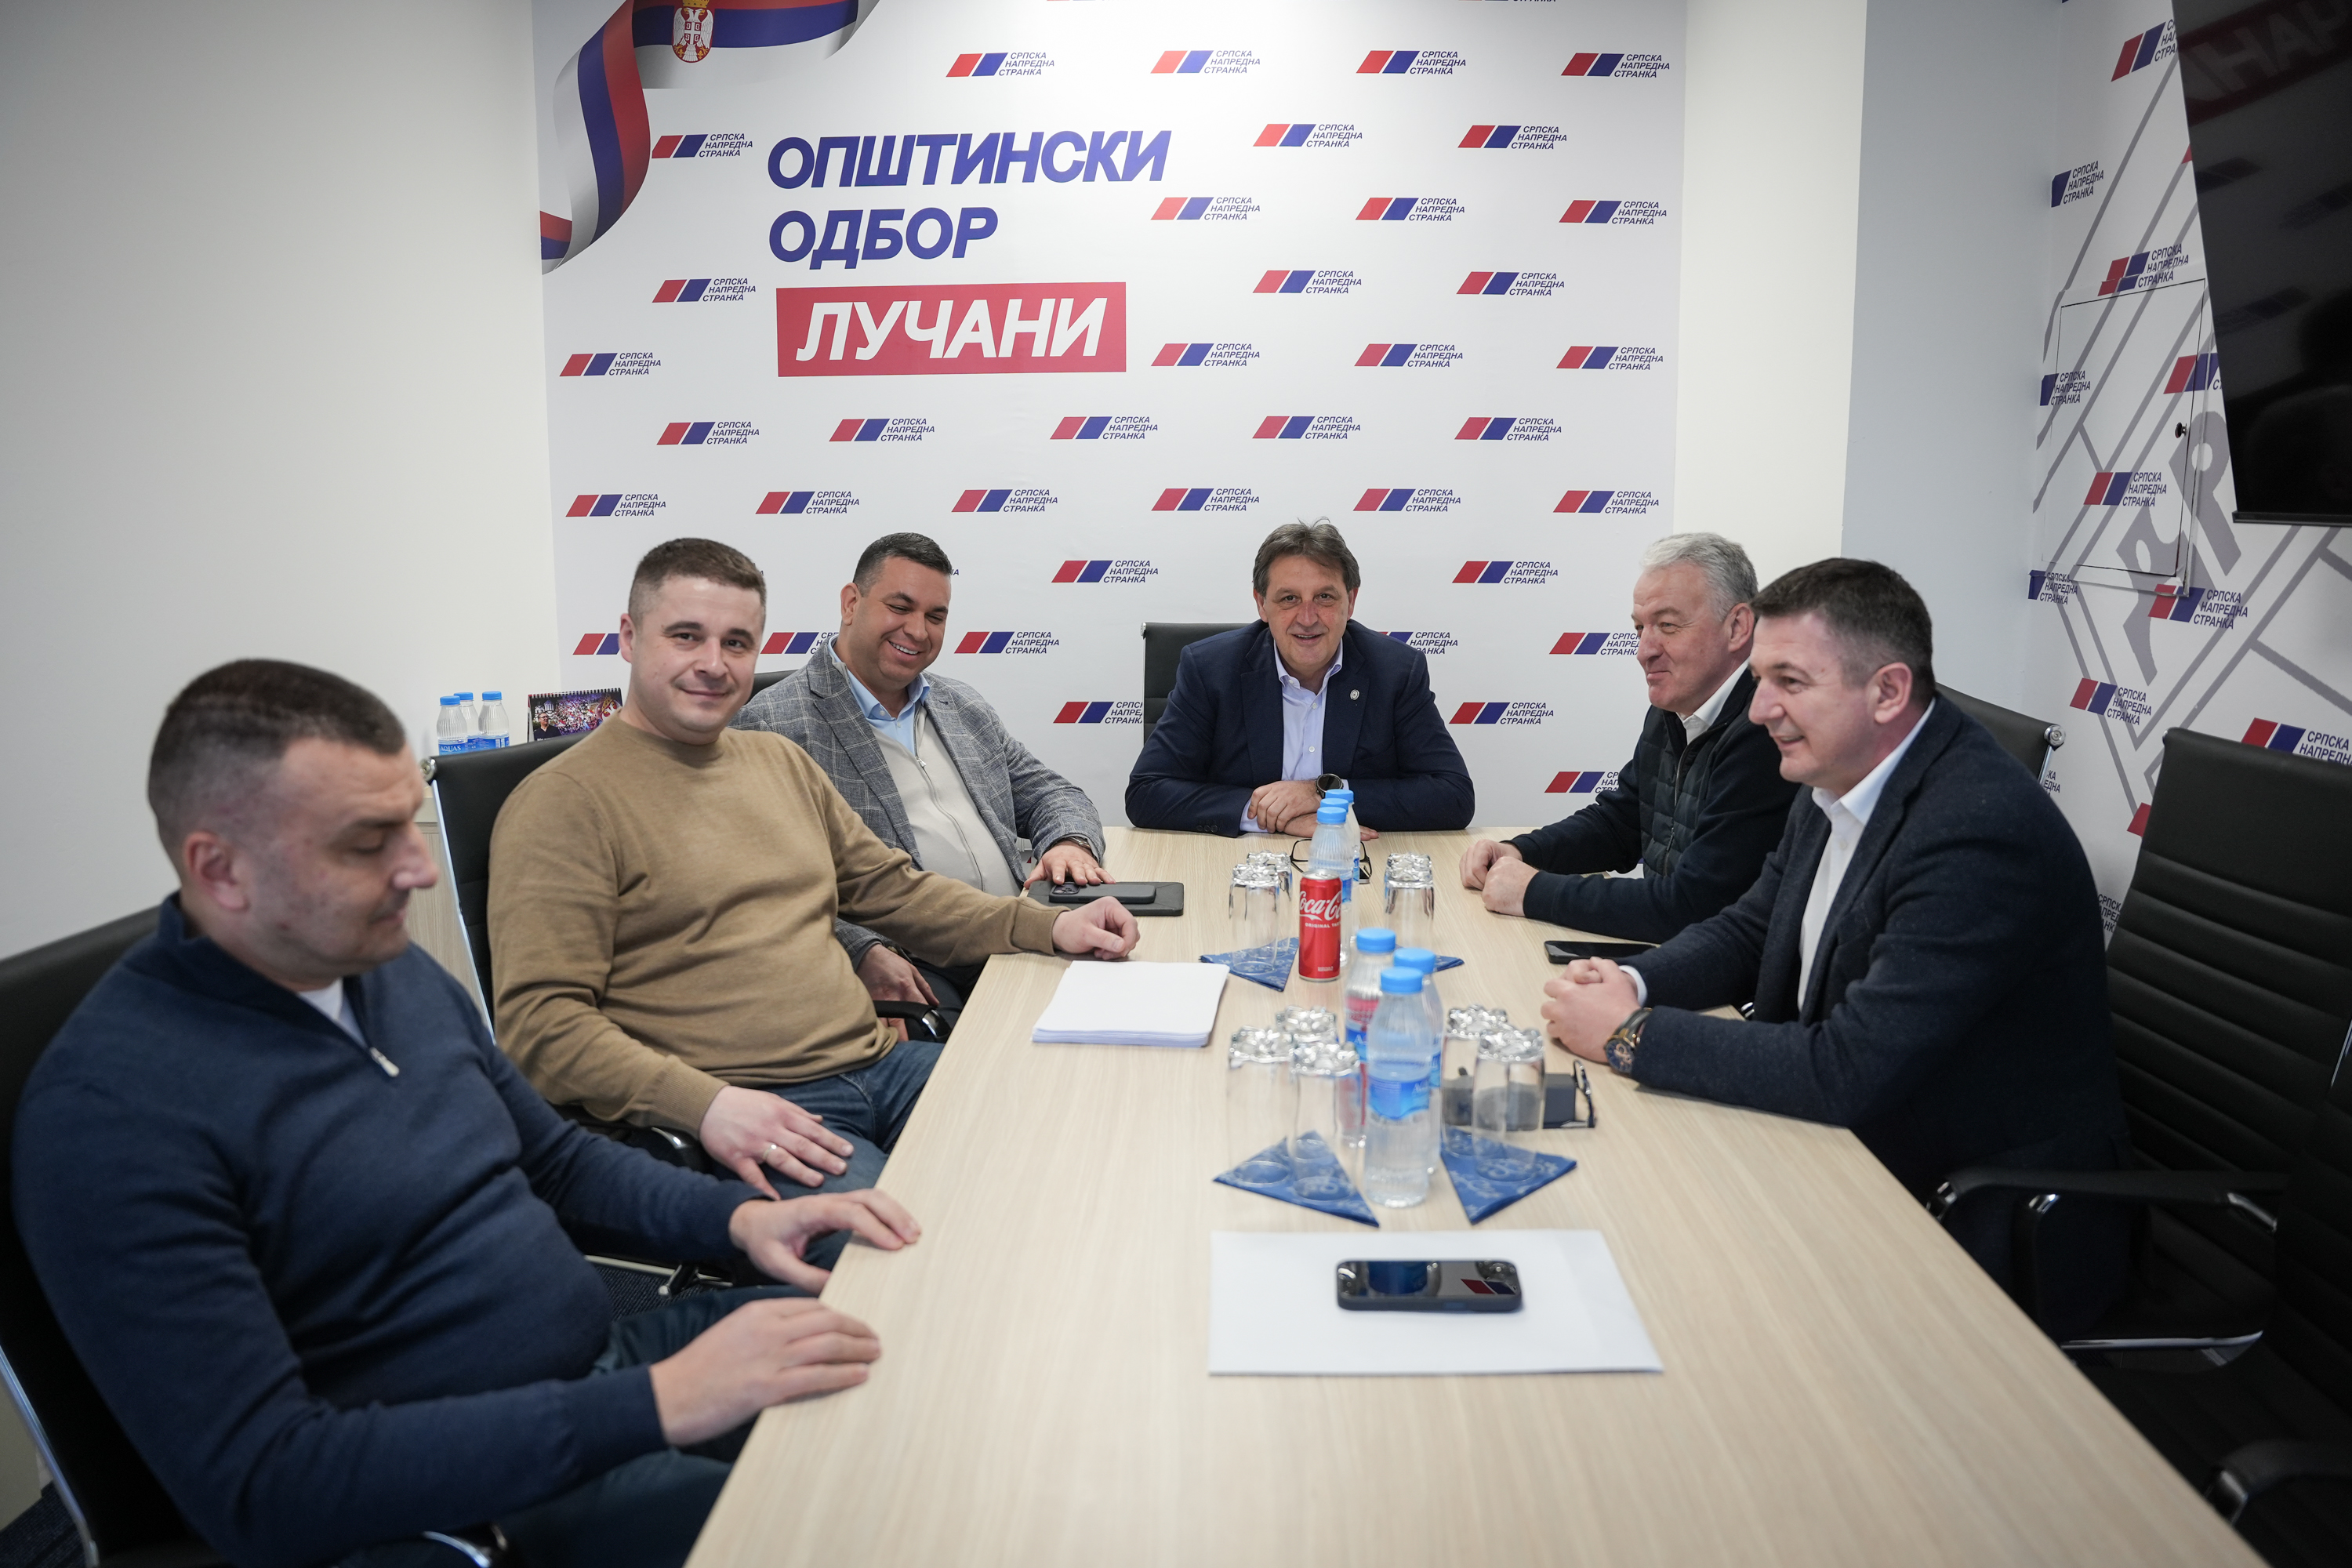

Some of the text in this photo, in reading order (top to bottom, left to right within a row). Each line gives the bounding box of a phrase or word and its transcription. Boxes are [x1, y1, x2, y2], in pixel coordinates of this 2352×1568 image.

[2154, 43, 2176, 62] СТРА
[1415, 59, 1466, 67] НАПРЕДНА
[1620, 62, 1670, 71] НАПРЕДНА
[710, 132, 745, 141] СРПСКА
[1312, 132, 1363, 140] НАПРЕДНА
[1517, 133, 1567, 143] НАПРЕДНА
[704, 140, 753, 149] НАПРЕДНА
[768, 130, 1172, 190] ОПШТИНСКИ
[2072, 161, 2099, 178] СРПСКА
[2068, 169, 2104, 191] НАПРЕДНА
[2063, 186, 2093, 205] СТРАНКА
[1210, 205, 1261, 213] НАПРЕДНА
[1415, 205, 1465, 214] НАПРЕДНА
[1617, 209, 1668, 217] НАПРЕДНА
[769, 206, 999, 270] ОДБОР
[2151, 243, 2182, 260] СРПСКА
[2147, 255, 2189, 273] НАПРЕДНА
[1312, 278, 1362, 287] НАПРЕДНА
[1515, 280, 1565, 289] НАПРЕДНА
[2138, 270, 2173, 288] СТРАНКА
[708, 285, 757, 294] НАПРЕДНА
[795, 297, 1108, 361] ЛУЧАНИ
[1210, 350, 1260, 359] НАПРЕДНА
[1614, 354, 1664, 363] НАПРЕДНА
[614, 359, 662, 368] НАПРЕДНА
[2060, 370, 2085, 382] СРПСКА
[2055, 380, 2091, 394] НАПРЕДНА
[2051, 394, 2081, 405] СТРАНКА
[1512, 425, 1562, 434] НАПРЕДНА
[2133, 472, 2161, 482] СРПСКА
[2128, 484, 2167, 496] НАПРЕДНА
[811, 498, 860, 506] НАПРЕДНА
[1009, 496, 1058, 505] НАПРЕДНА
[1210, 495, 1260, 504] НАПРЕДНА
[1411, 496, 1461, 505] НАПРЕДНА
[1610, 499, 1660, 507] НАПРЕДНА
[2122, 496, 2155, 506] СТРАНКА
[1509, 568, 1559, 577] НАПРЕДНА
[2045, 582, 2078, 595] НАПРЕДНА
[2040, 593, 2068, 604] СТРАНКА
[2207, 590, 2241, 603] СРПСКА
[2200, 601, 2248, 618] НАПРЕДНА
[2194, 614, 2234, 630] СТРАНКА
[1410, 639, 1458, 648] НАПРЕДНА
[2118, 687, 2147, 702] СРПСКА
[2113, 697, 2152, 716] НАПРЕДНА
[2107, 708, 2140, 725] СТРАНКА
[2307, 731, 2350, 751] СРПСКА
[2299, 742, 2352, 765] НАПРЕДН
[2044, 779, 2060, 793] ЕДНА
[2098, 894, 2122, 912] СРПСК
